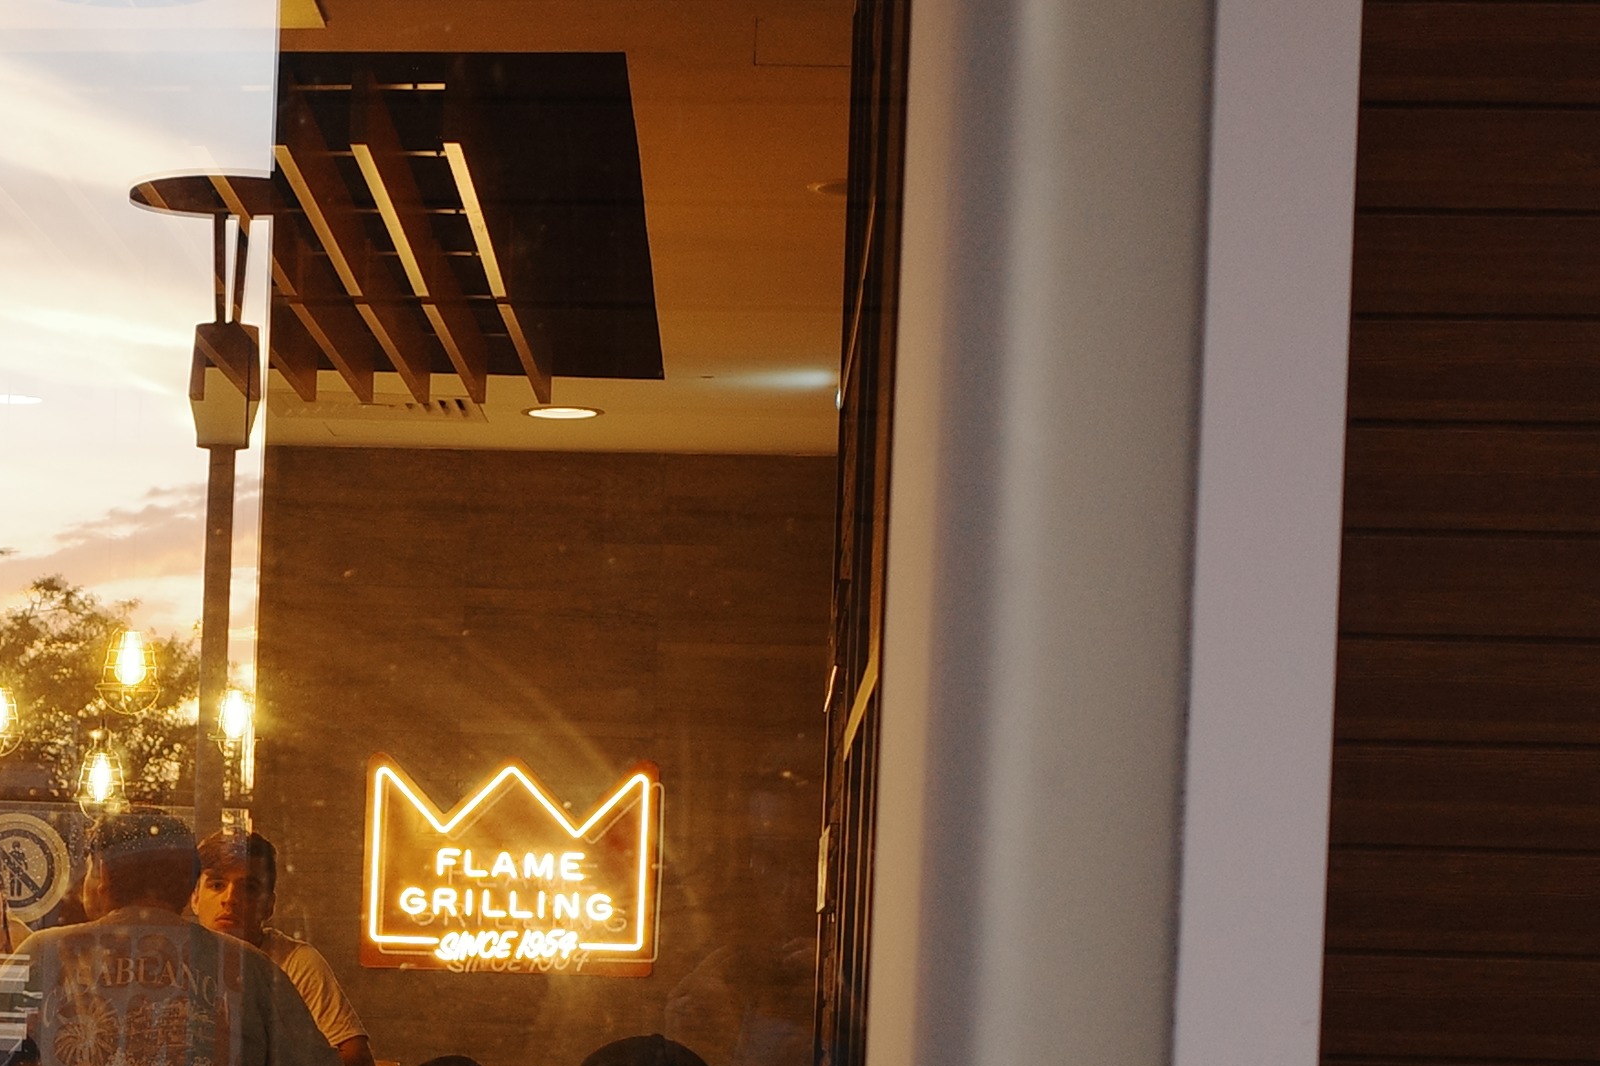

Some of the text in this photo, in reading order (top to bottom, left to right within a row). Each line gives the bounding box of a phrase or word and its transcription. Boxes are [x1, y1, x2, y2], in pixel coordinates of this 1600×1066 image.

[436, 847, 585, 881] FLAME
[400, 887, 614, 921] GRILLING
[435, 929, 581, 961] SINCE 1954
